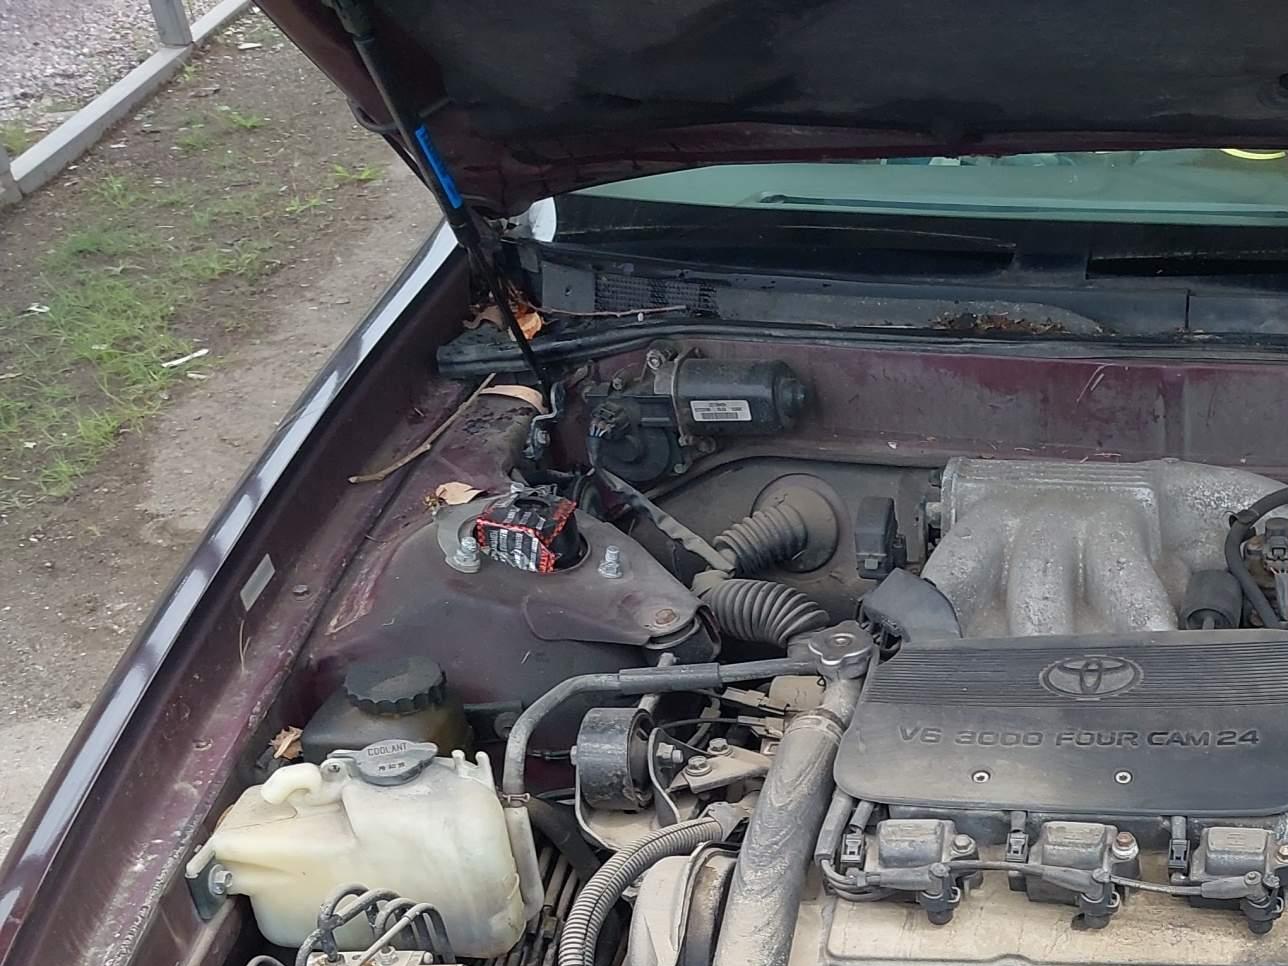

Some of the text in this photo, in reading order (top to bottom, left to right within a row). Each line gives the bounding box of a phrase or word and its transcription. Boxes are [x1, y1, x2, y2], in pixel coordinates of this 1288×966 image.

[899, 727, 1261, 746] V6 3000 FOUR CAM 24
[367, 742, 407, 756] COOLANT
